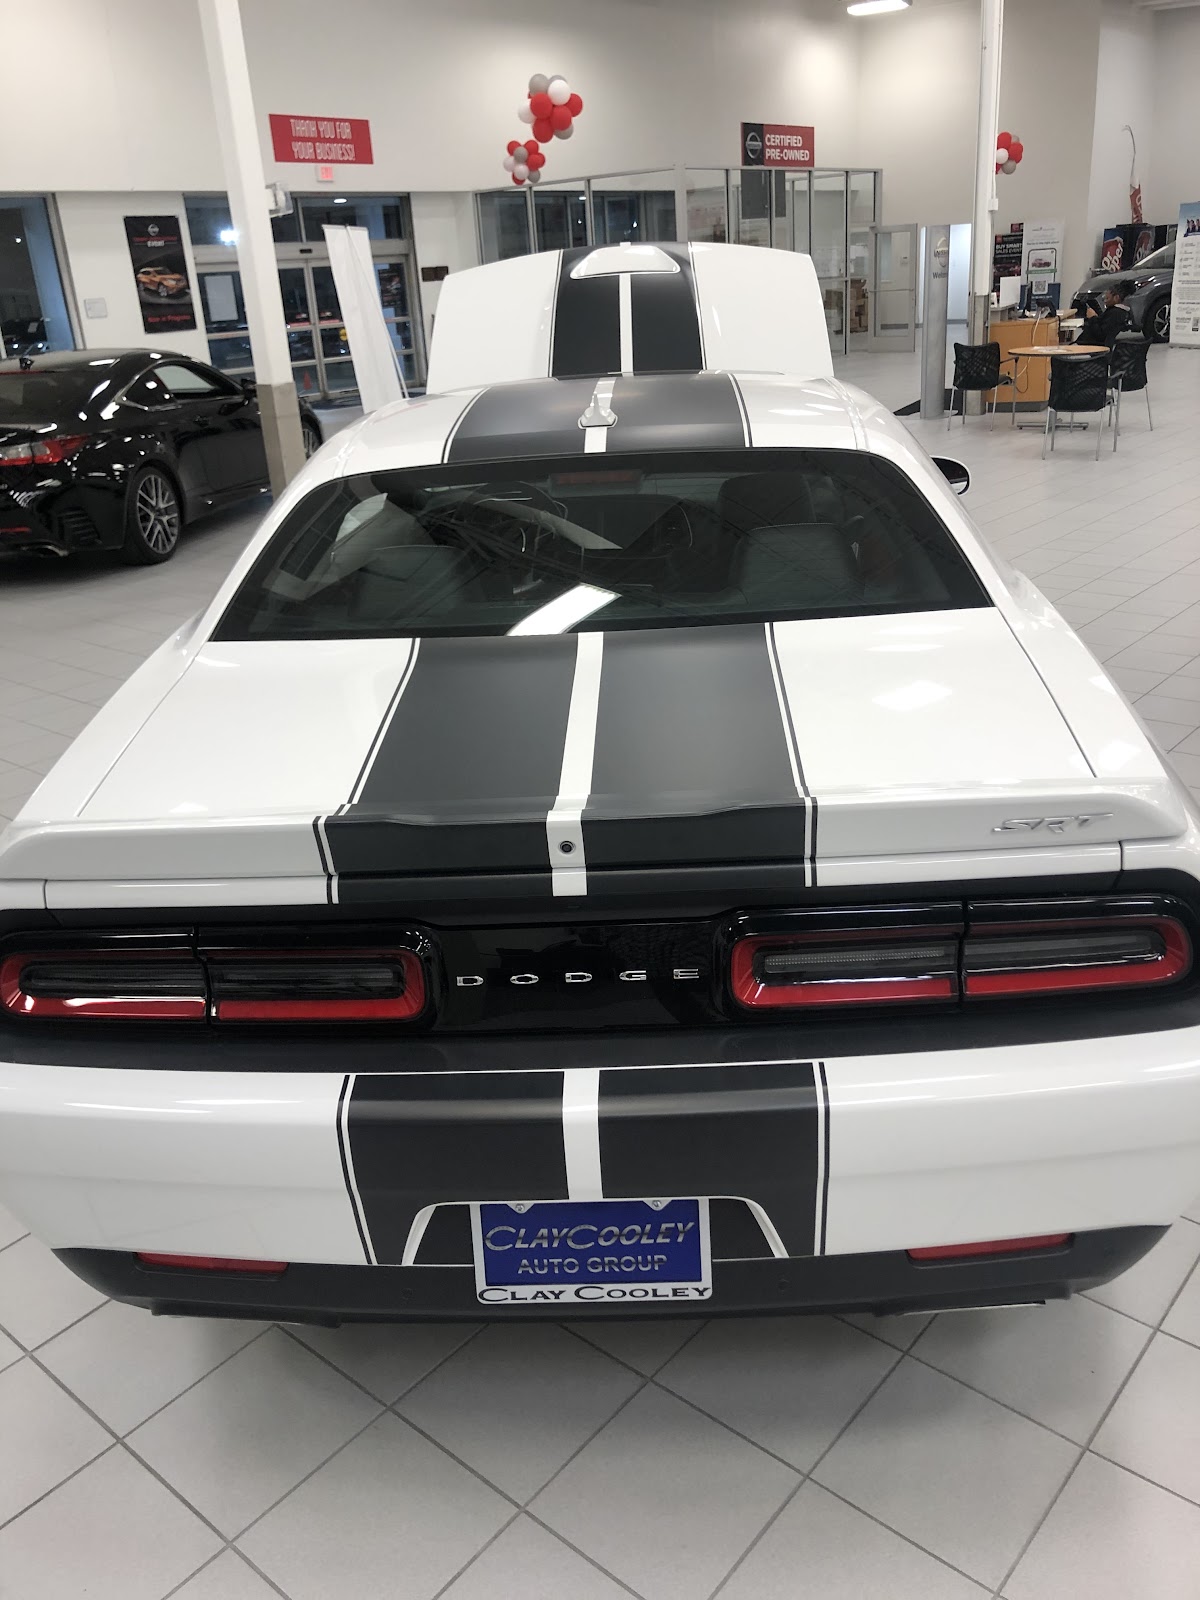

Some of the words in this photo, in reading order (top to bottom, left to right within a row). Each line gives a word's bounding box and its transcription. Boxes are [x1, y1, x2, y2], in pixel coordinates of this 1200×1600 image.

[290, 119, 317, 137] THANK
[318, 121, 335, 139] YOU
[336, 121, 351, 139] FOR
[765, 134, 803, 147] CERTIFIED
[291, 142, 315, 159] YOUR
[315, 142, 355, 161] BUSINESS!
[765, 149, 810, 161] PRE-OWNED
[456, 968, 700, 986] DODGE
[518, 1258, 580, 1275] AUTO
[587, 1255, 668, 1273] GROUP
[478, 1287, 566, 1302] CLAY
[574, 1286, 713, 1301] COOLEY
